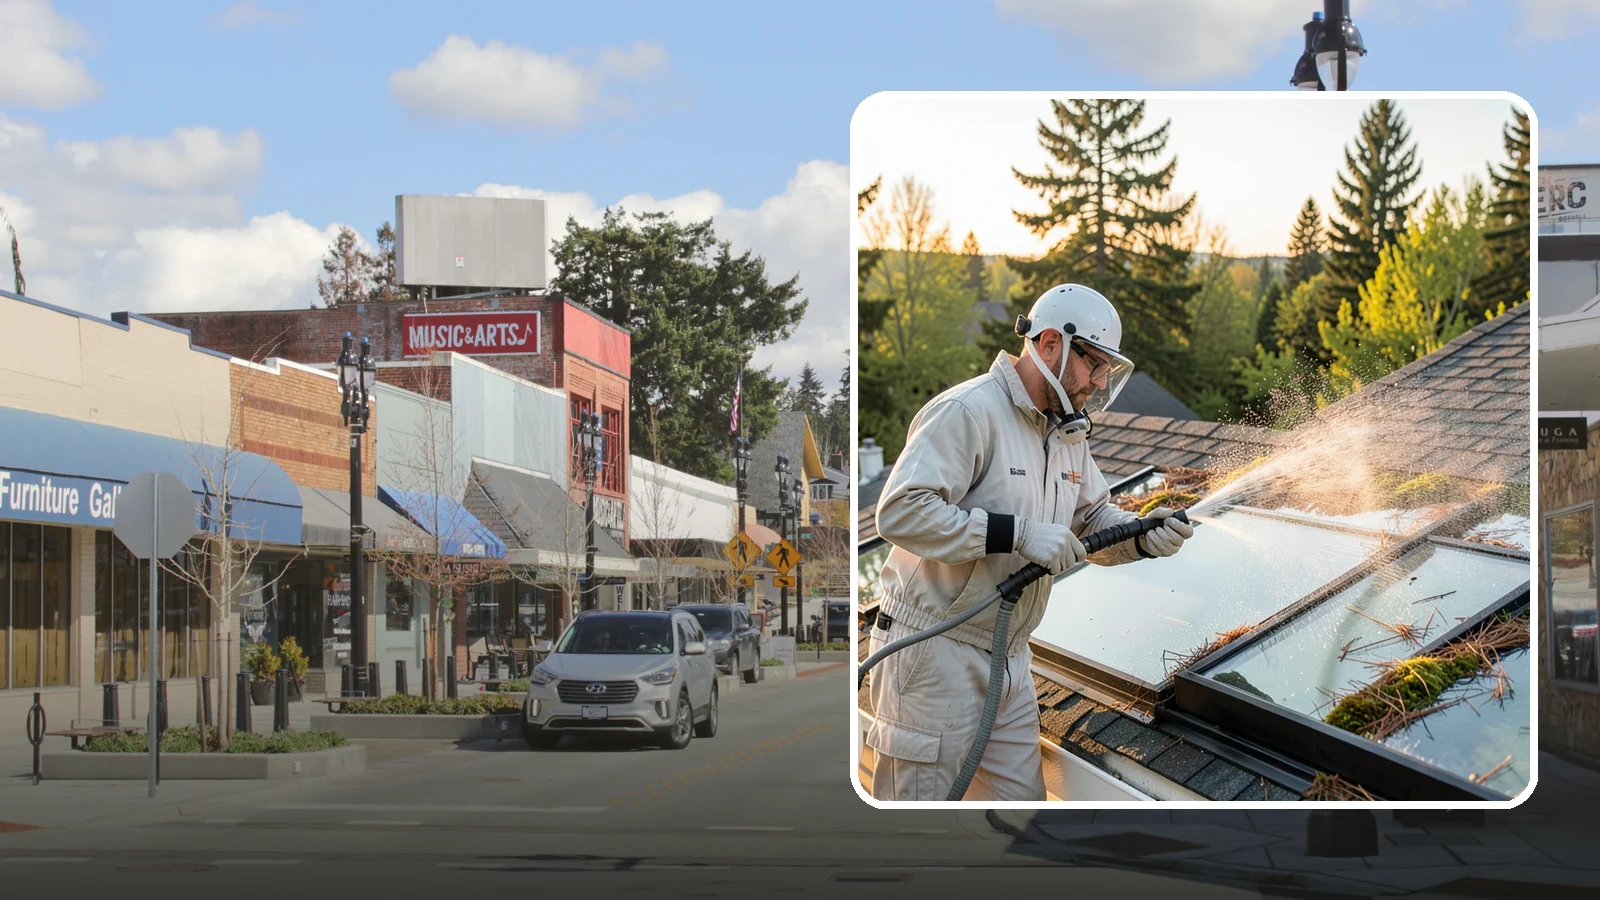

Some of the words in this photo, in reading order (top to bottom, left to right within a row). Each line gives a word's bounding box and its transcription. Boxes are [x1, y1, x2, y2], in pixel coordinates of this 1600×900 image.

[408, 322, 519, 349] MUSIC&ARTS
[1540, 427, 1577, 437] UGA
[0, 471, 80, 515] Furniture
[89, 482, 122, 519] Gal
[453, 563, 479, 574] SUSHI
